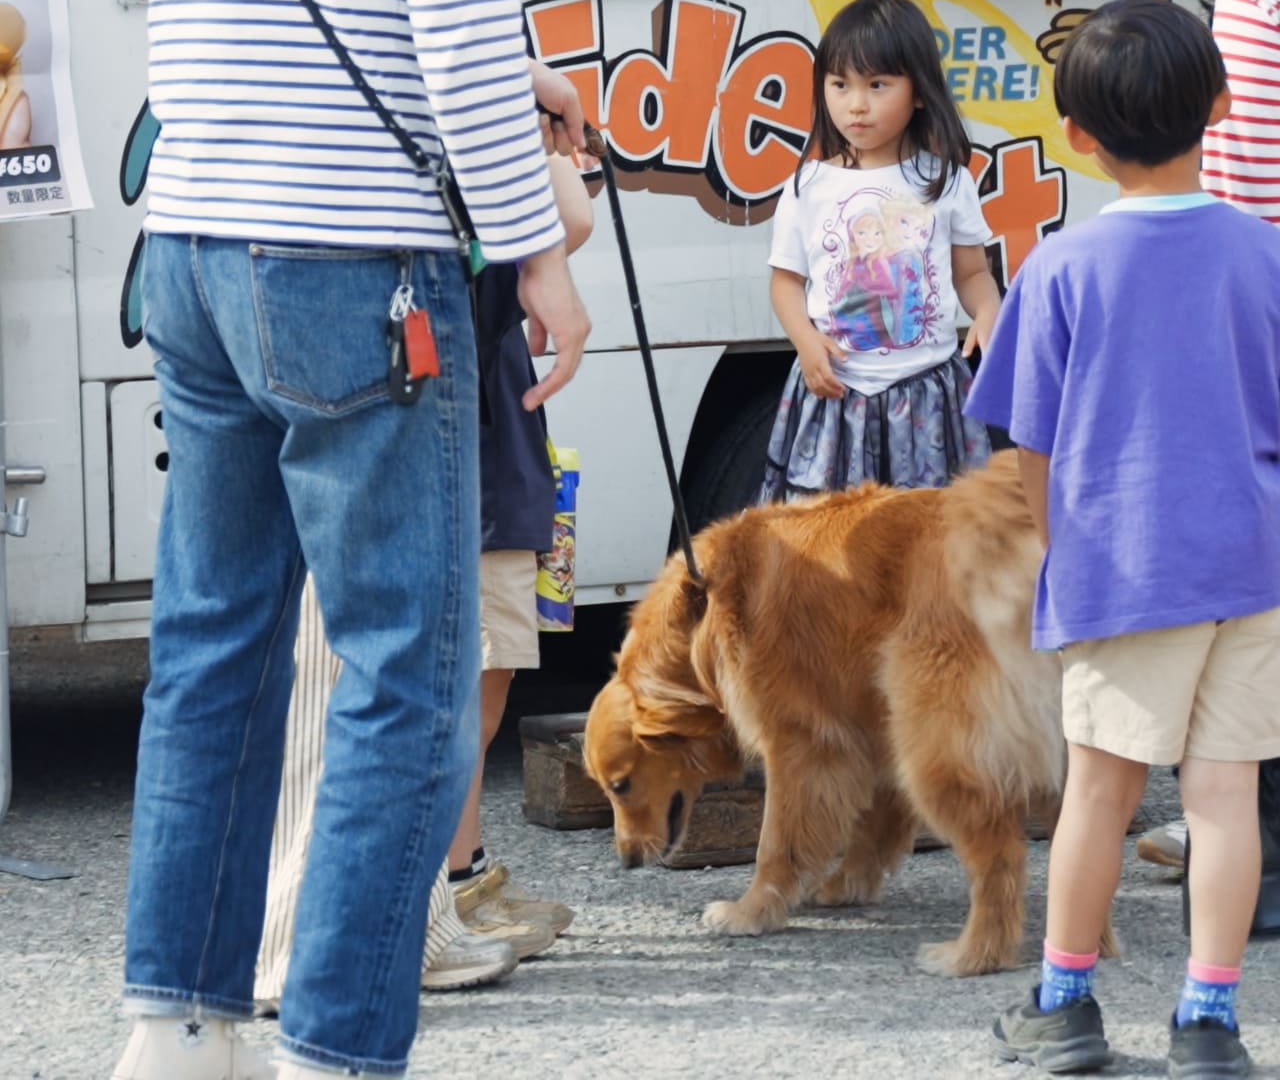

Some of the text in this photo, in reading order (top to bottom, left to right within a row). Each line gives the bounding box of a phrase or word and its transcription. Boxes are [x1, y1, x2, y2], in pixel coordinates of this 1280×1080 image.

[946, 63, 1040, 102] ERE!
[7, 187, 64, 206] 数量限定
